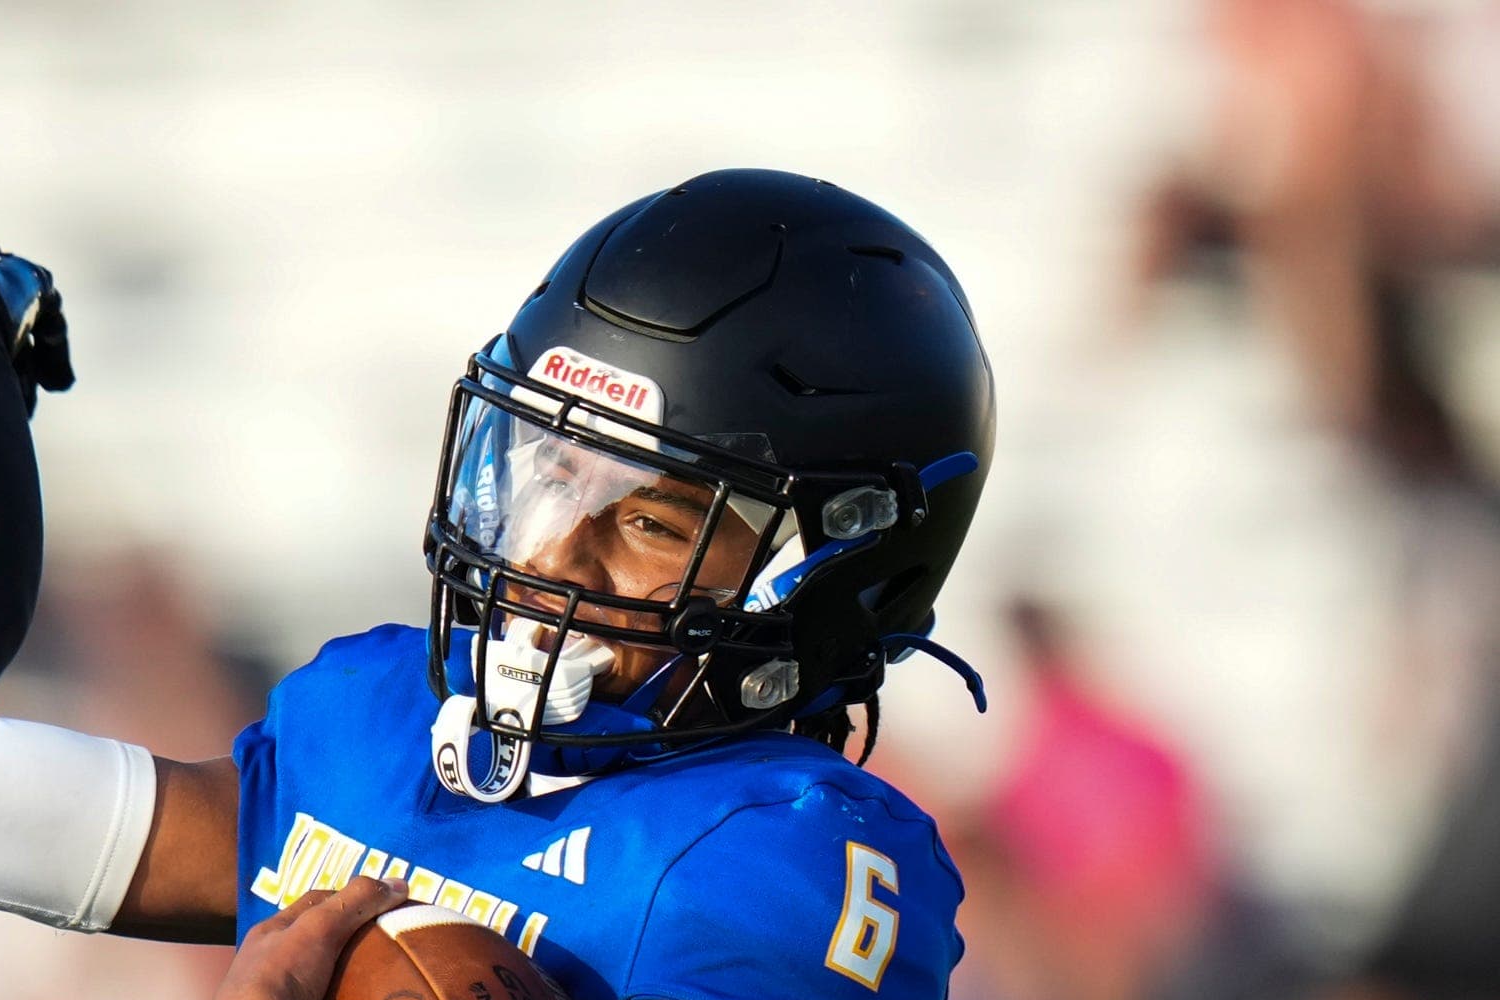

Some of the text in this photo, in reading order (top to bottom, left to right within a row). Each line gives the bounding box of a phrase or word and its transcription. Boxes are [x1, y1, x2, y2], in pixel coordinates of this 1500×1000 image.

[543, 354, 649, 410] Riddell
[500, 666, 541, 684] BATTLE
[825, 841, 900, 992] 6
